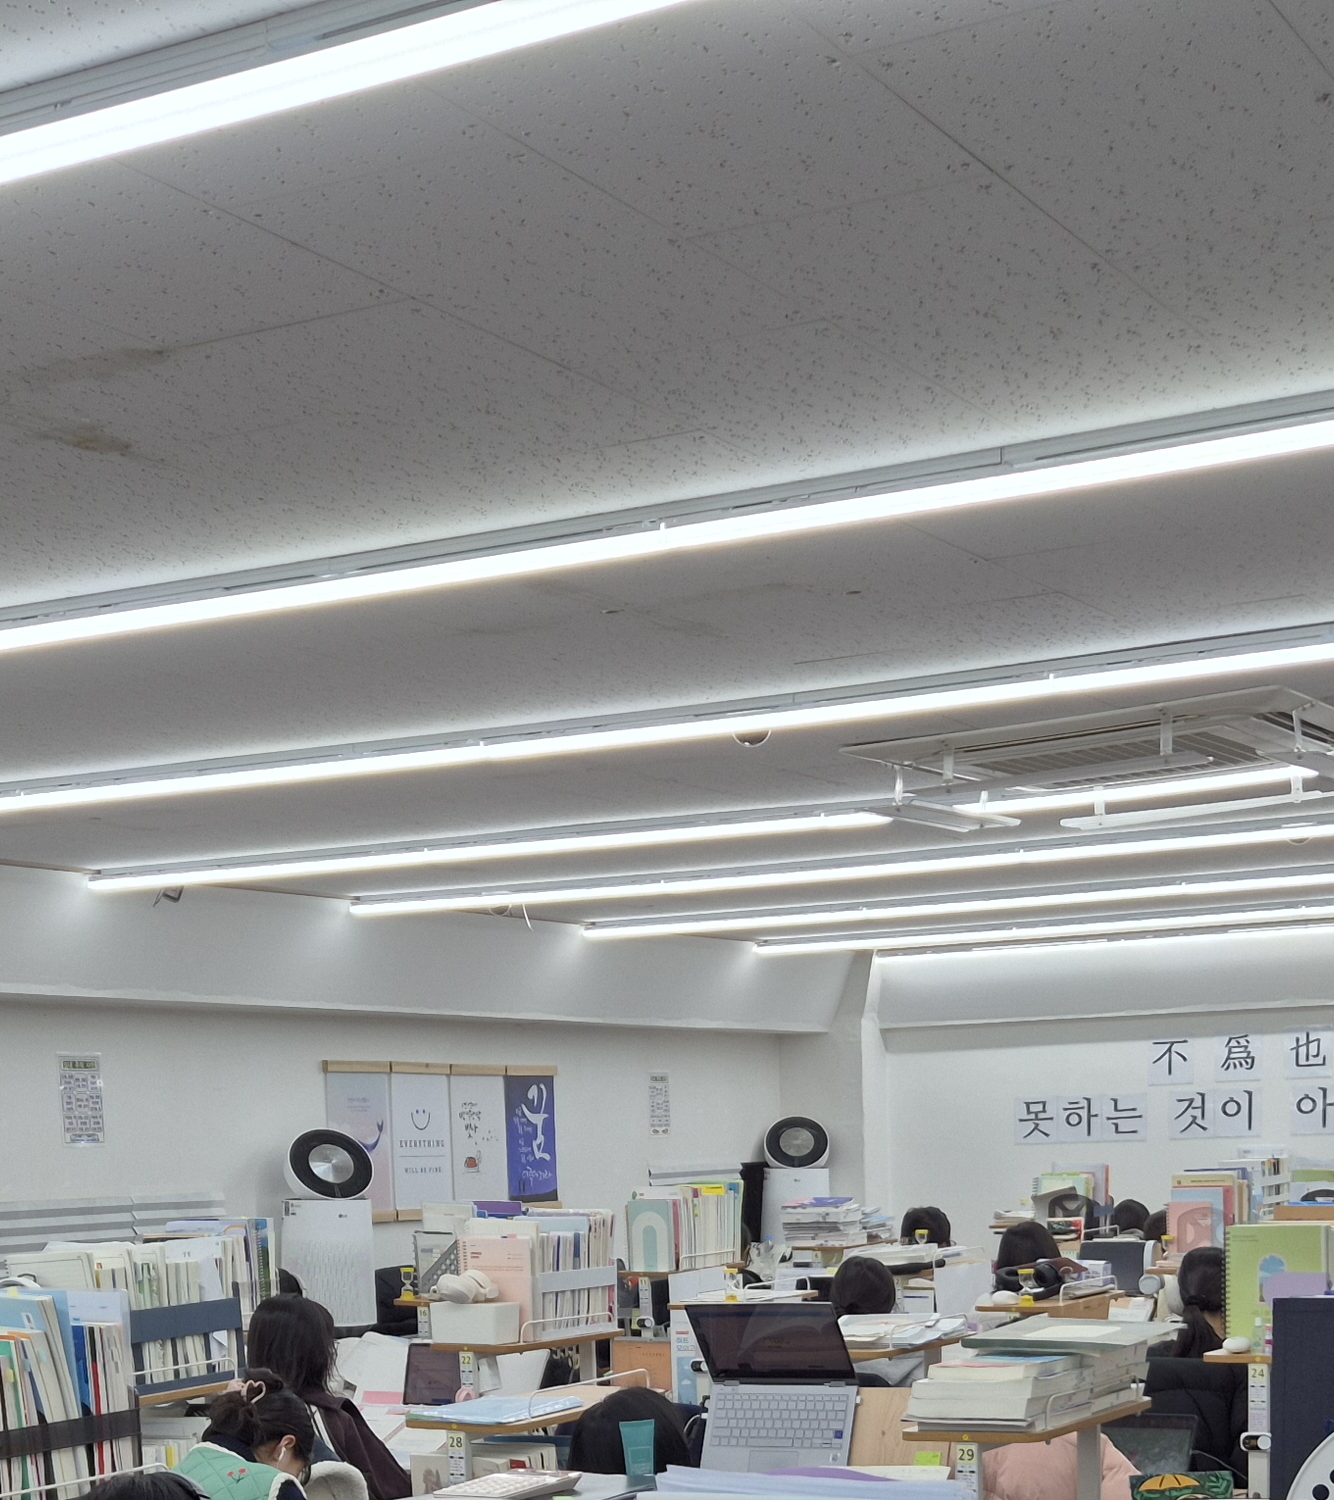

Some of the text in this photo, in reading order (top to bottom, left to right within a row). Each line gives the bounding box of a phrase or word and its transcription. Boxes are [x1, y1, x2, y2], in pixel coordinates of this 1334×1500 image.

[1017, 1097, 1144, 1139] 못하는
[1174, 1090, 1253, 1133] 것이
[399, 1139, 445, 1149] EVERYTHING
[461, 1356, 472, 1365] 22
[1251, 1368, 1265, 1378] 24
[449, 1436, 463, 1448] 28
[958, 1448, 975, 1462] 29
